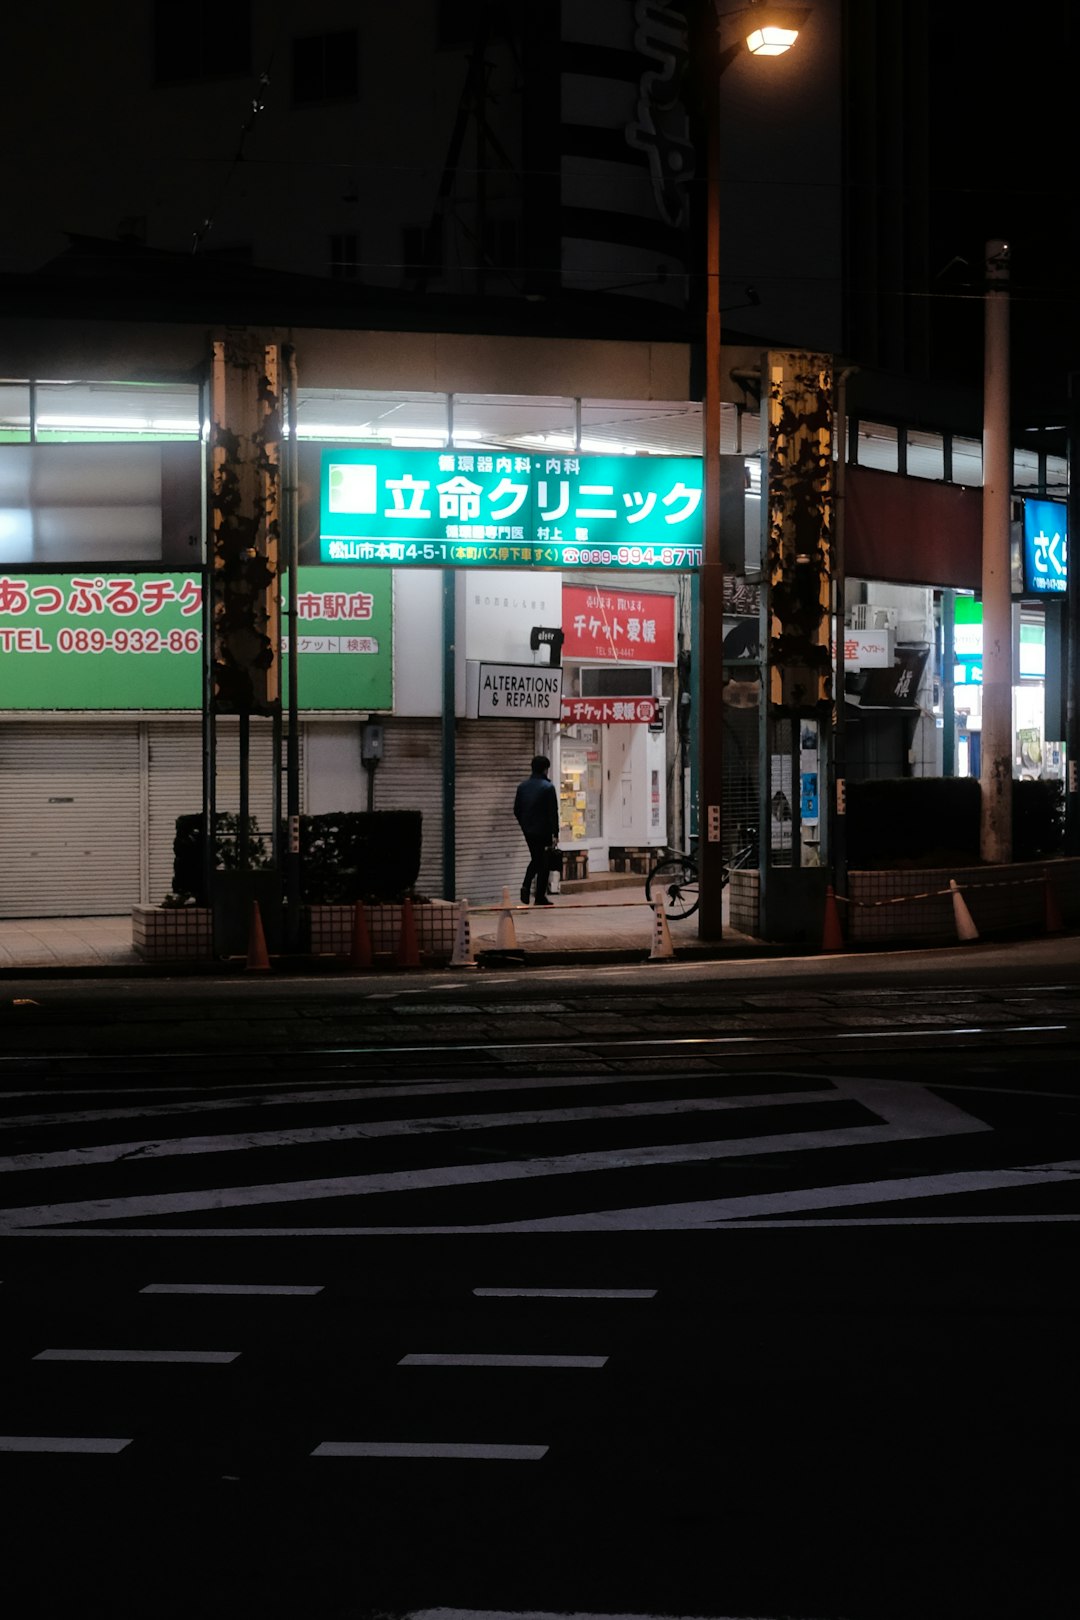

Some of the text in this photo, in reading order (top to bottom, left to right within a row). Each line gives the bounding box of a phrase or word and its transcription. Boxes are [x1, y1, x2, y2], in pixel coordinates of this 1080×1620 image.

[384, 474, 702, 525] 立命クリニック
[445, 525, 524, 540] 専門医
[537, 527, 563, 541] 村上
[580, 547, 702, 566] 089-994-8711
[297, 592, 373, 620] 市駅店
[573, 615, 656, 644] チケット愛媛
[0, 628, 203, 653] TEL 089-932-86
[346, 639, 372, 652] 検索
[483, 675, 559, 693] ALTERATIONS
[492, 692, 550, 709] & REPAIRS
